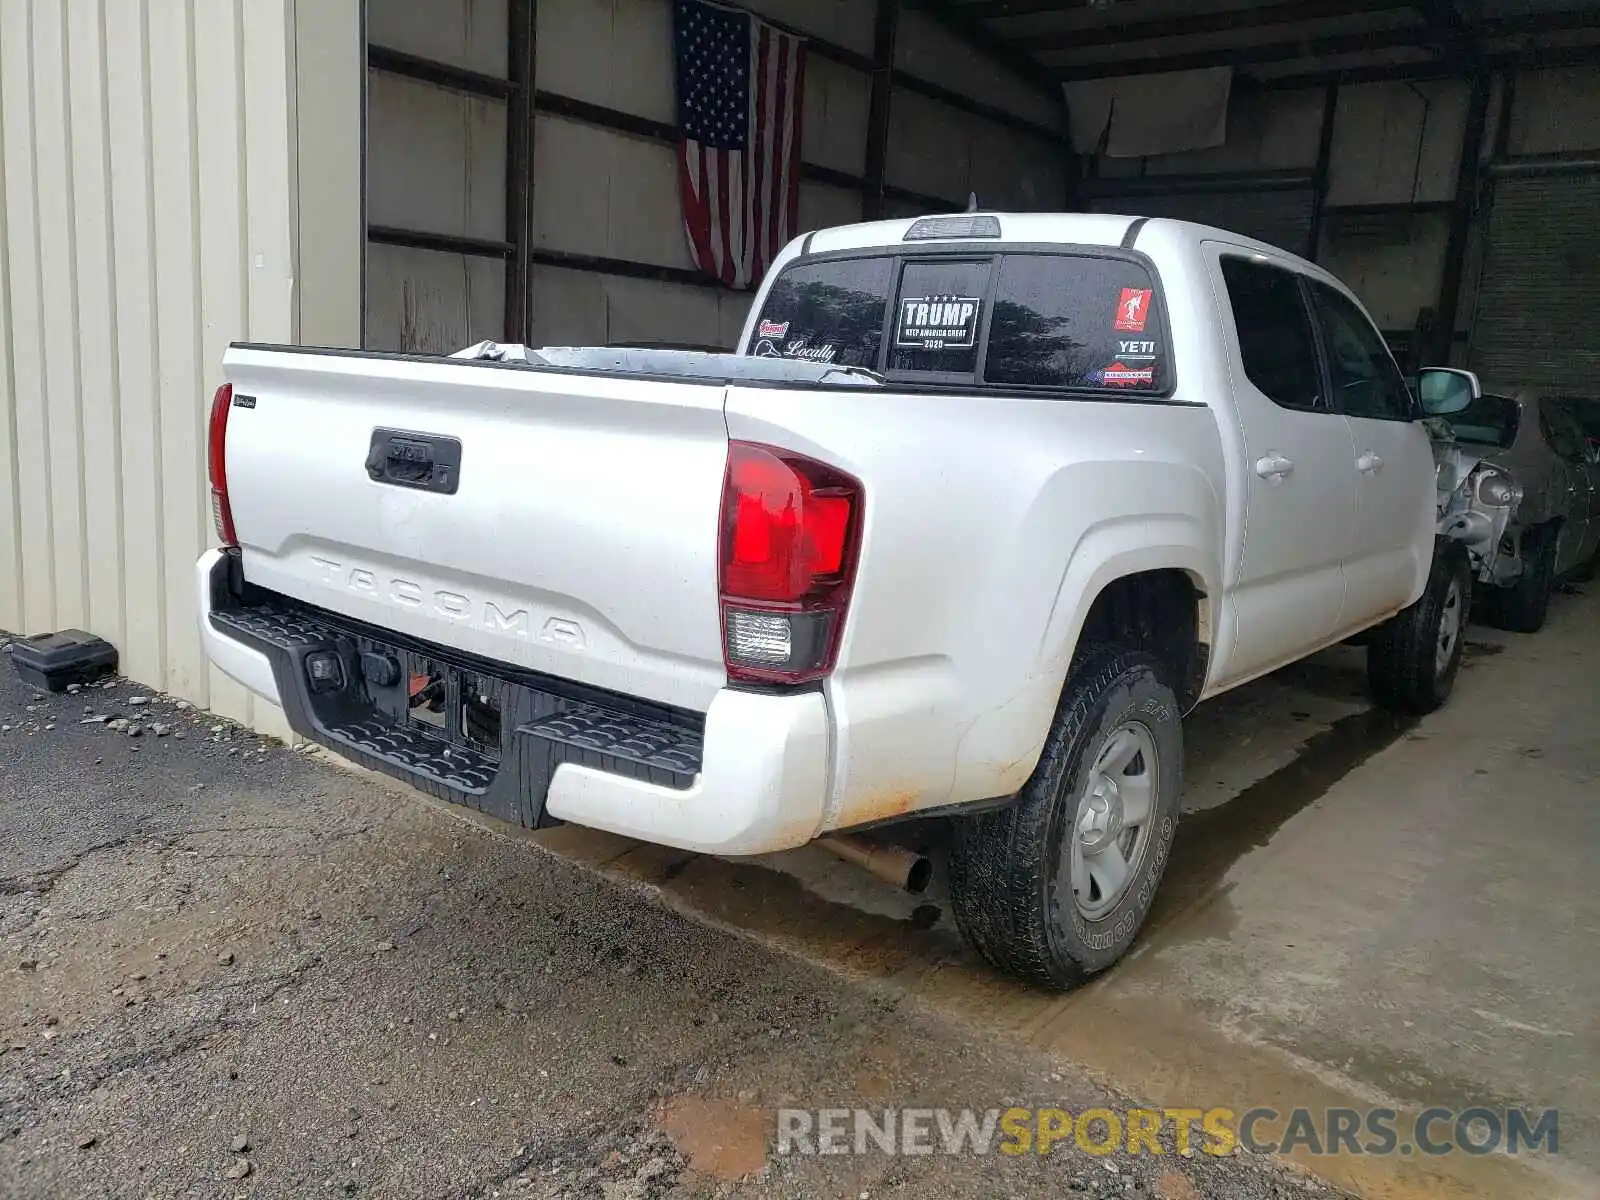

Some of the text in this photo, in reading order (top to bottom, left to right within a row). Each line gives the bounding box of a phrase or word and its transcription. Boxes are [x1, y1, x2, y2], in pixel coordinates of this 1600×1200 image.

[906, 303, 974, 326] TRUMP
[905, 328, 920, 337] KEEP
[784, 340, 836, 362] Locally
[924, 339, 944, 349] 2020
[1119, 340, 1155, 353] YETI
[310, 555, 588, 650] TACOMA
